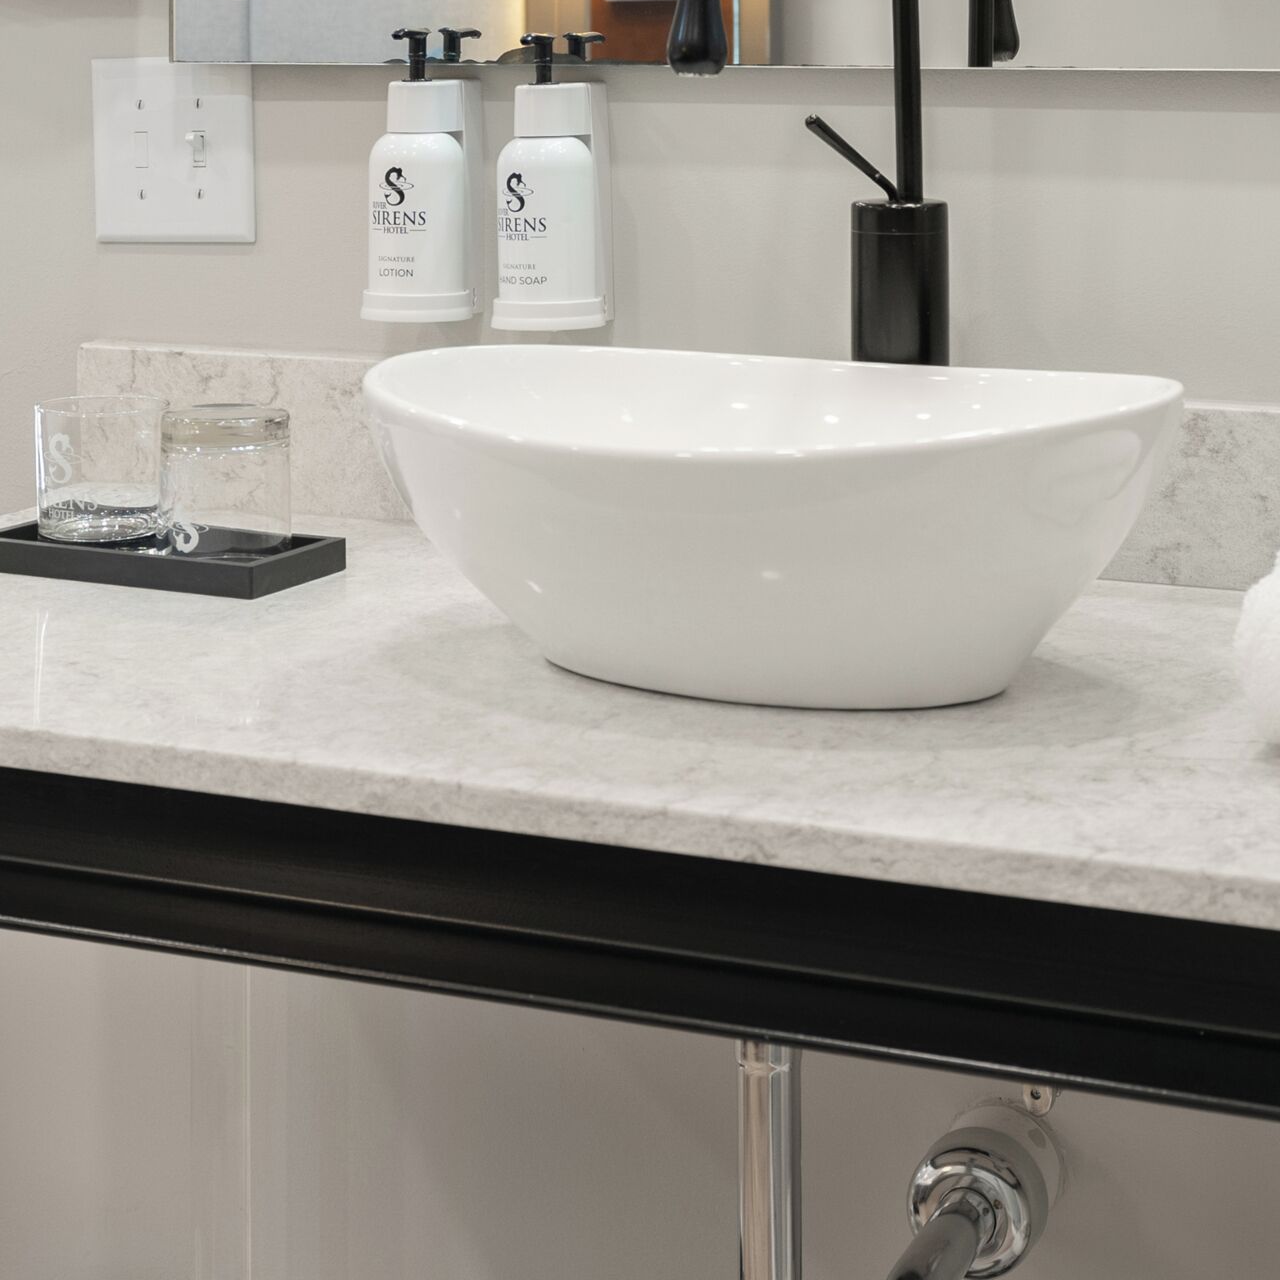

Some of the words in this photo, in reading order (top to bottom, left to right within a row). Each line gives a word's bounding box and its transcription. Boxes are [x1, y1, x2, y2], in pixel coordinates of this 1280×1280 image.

[372, 210, 426, 226] SIRENS
[383, 226, 408, 234] HOTEL
[506, 233, 529, 241] HOTEL
[379, 268, 414, 278] LOTION
[519, 276, 548, 285] SOAP
